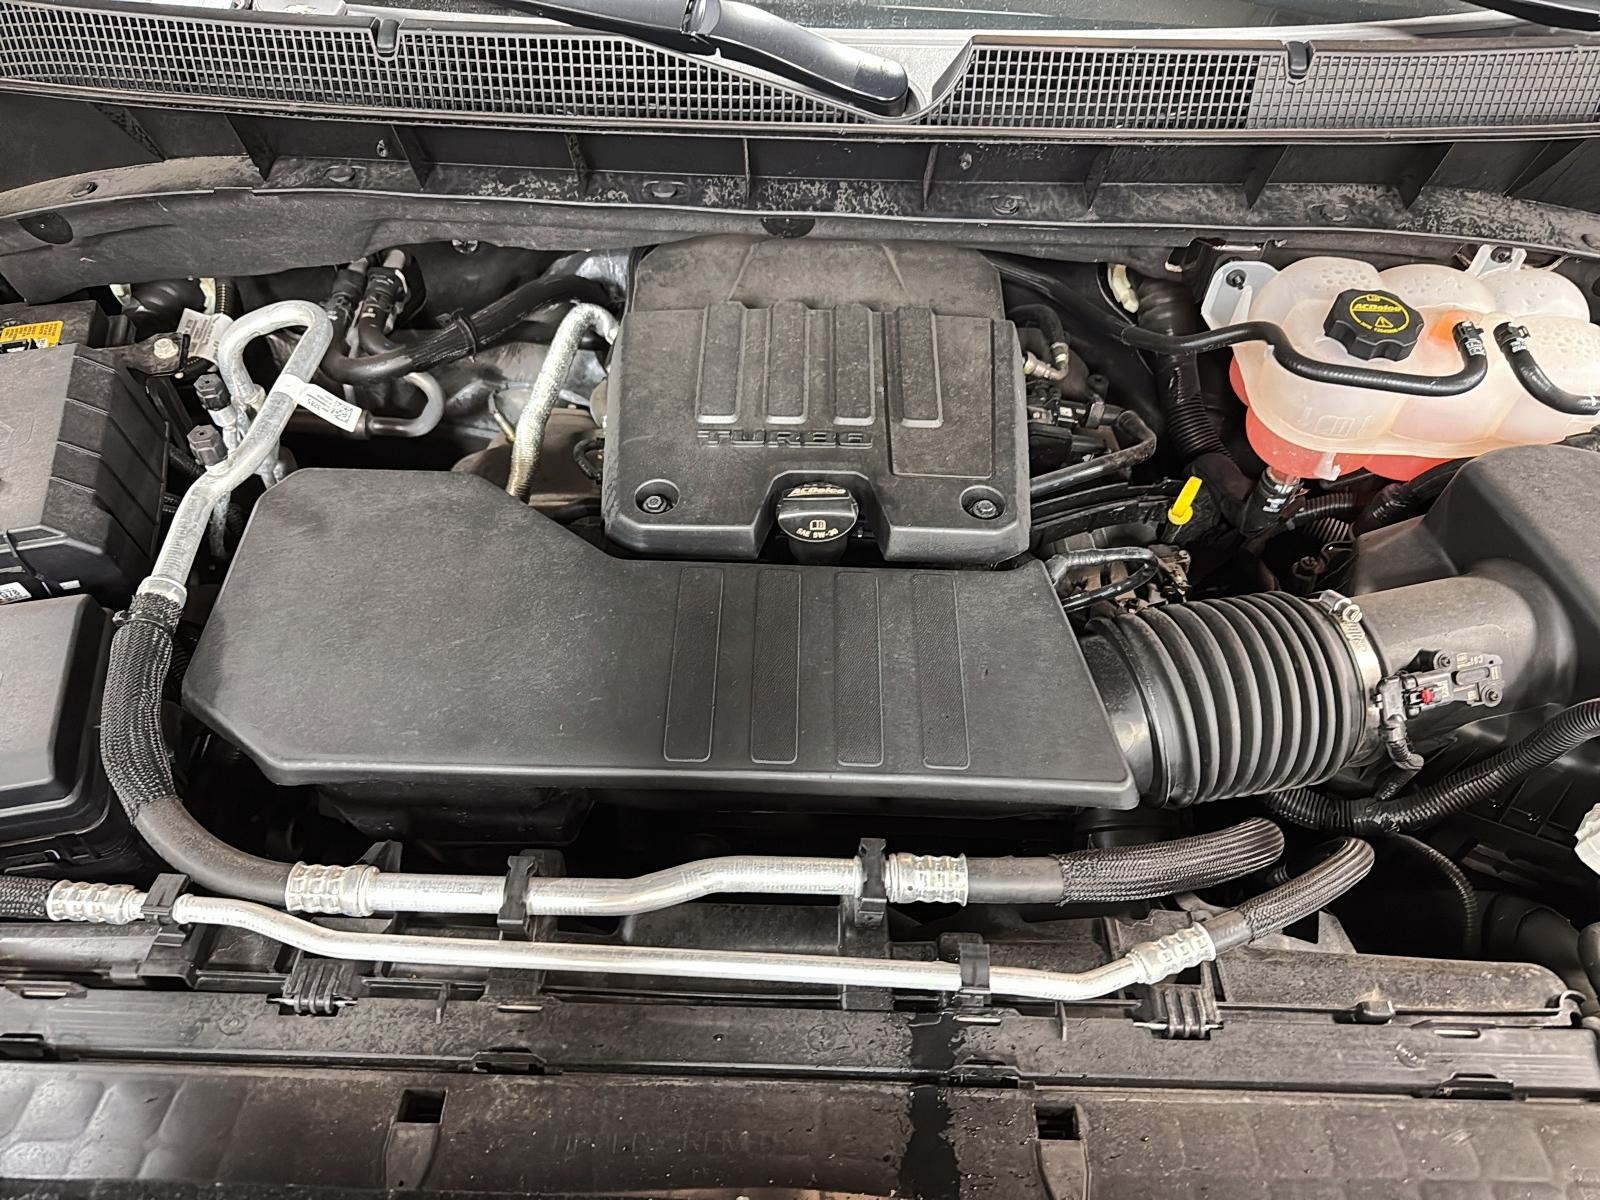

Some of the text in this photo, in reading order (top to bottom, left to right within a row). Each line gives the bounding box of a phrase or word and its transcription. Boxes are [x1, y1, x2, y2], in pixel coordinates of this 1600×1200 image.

[696, 429, 873, 448] TURBO
[788, 488, 846, 496] ACDelco
[796, 528, 812, 538] SAE
